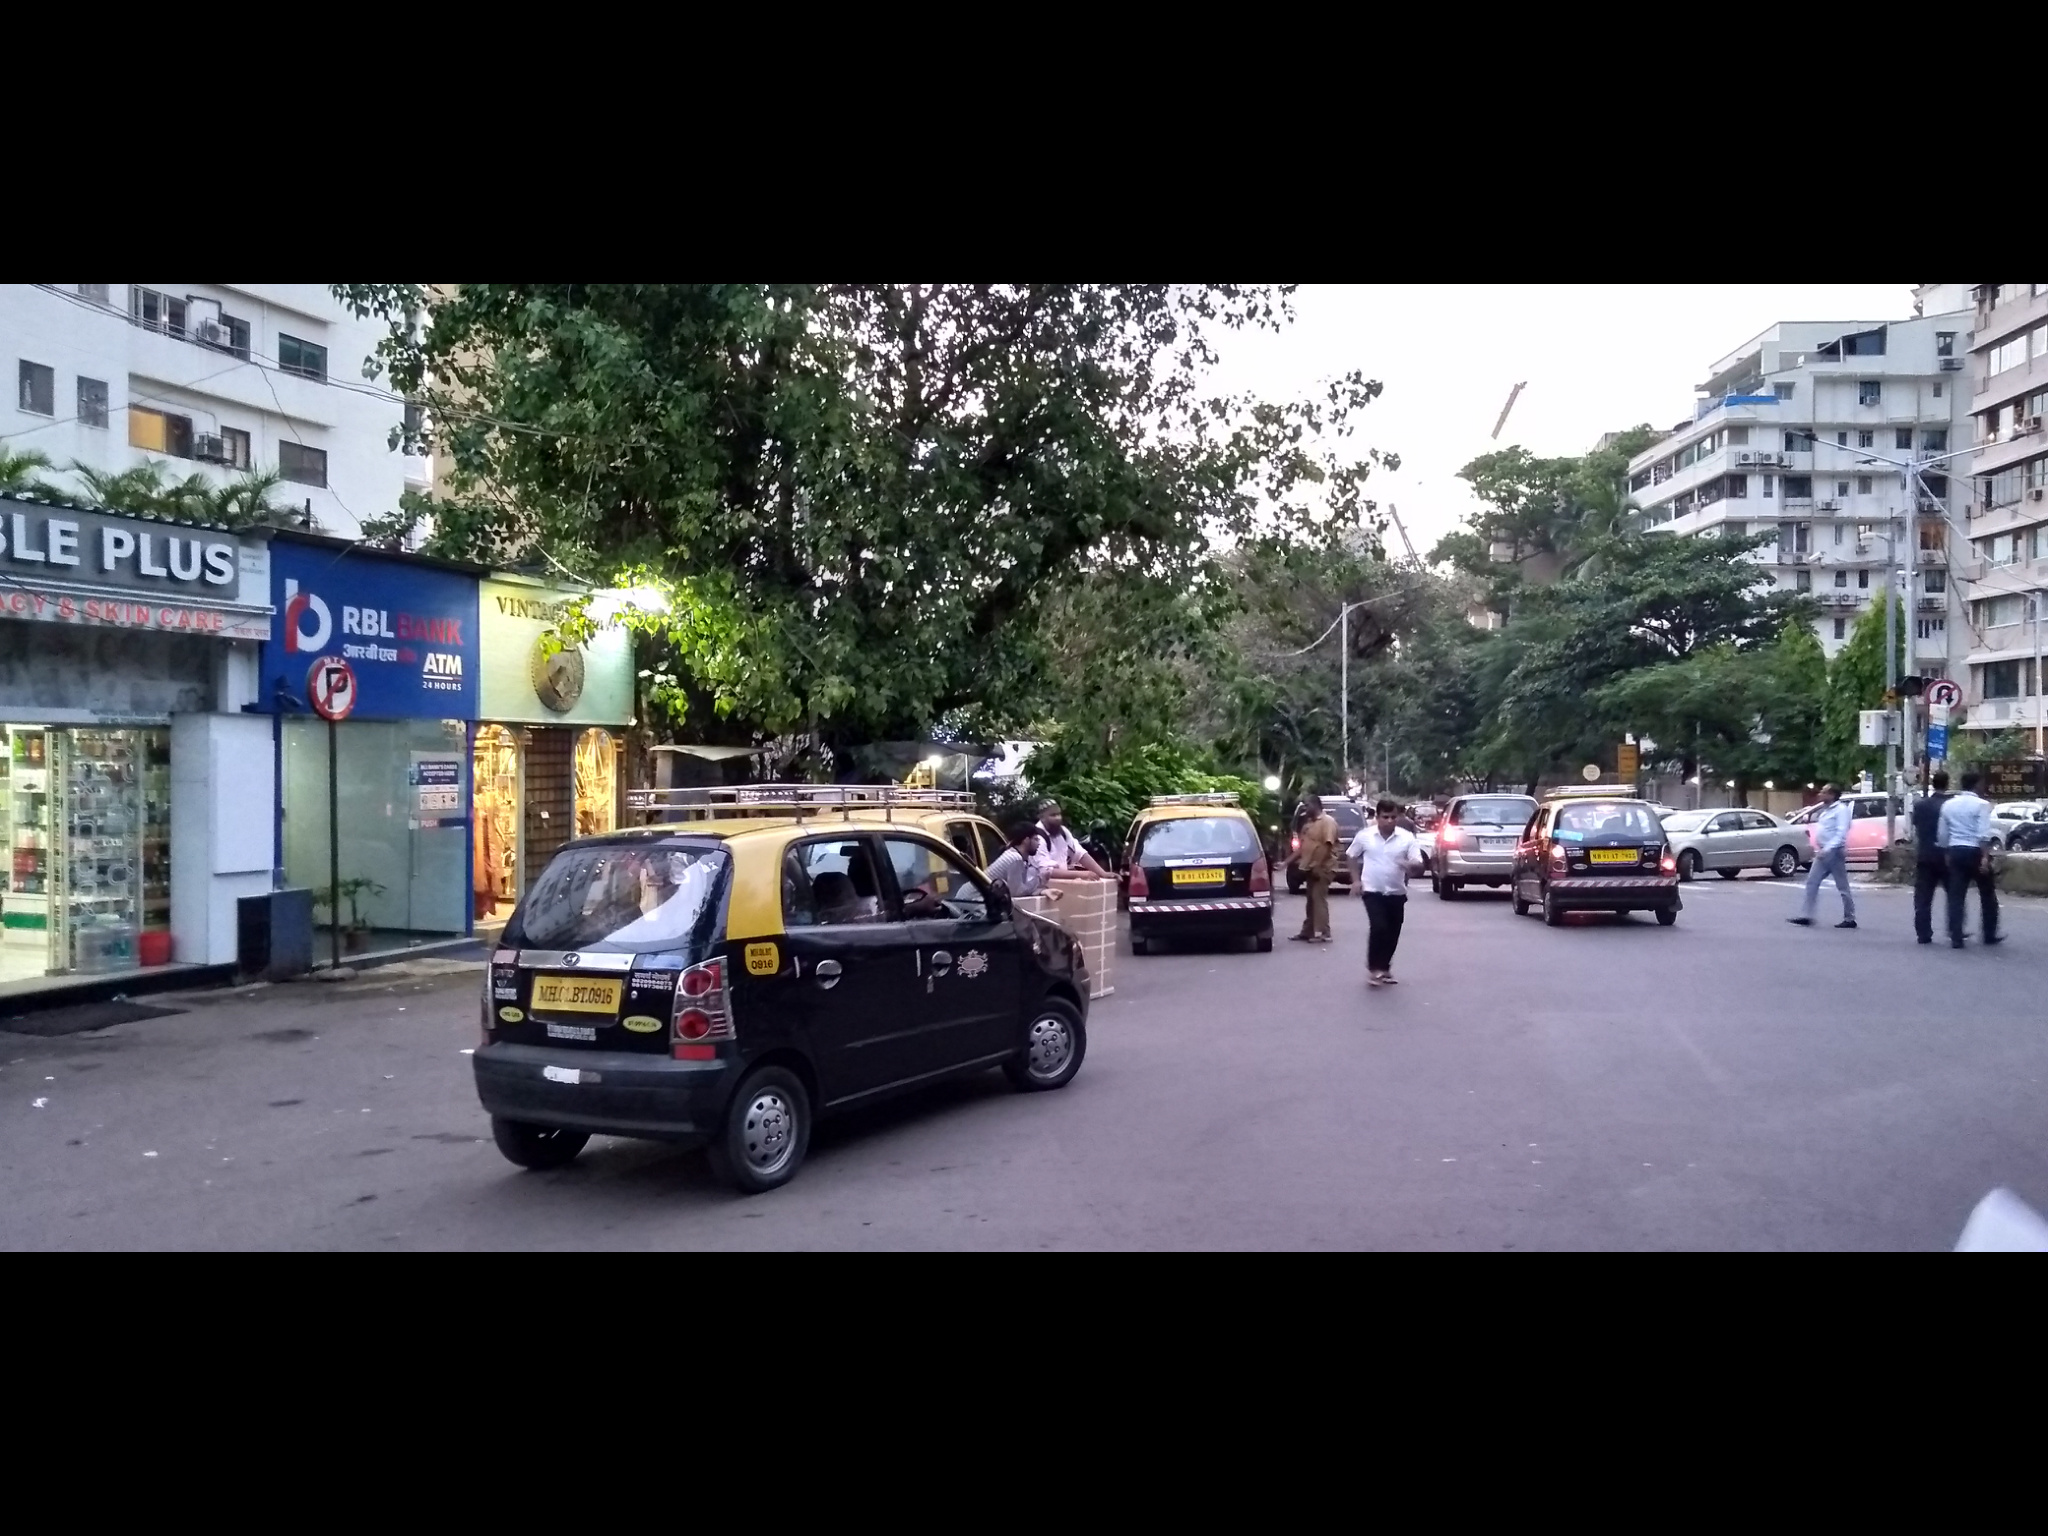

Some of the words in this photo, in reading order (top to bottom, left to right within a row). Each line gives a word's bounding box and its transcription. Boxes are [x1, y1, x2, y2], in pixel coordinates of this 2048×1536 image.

[0, 513, 80, 566] LE
[103, 526, 234, 585] PLUS
[59, 597, 75, 617] &
[86, 599, 149, 623] SKIN
[159, 607, 224, 631] CARE
[343, 605, 395, 638] RBL
[398, 613, 463, 646] BANK
[422, 653, 462, 676] ATM
[422, 681, 433, 689] 24
[434, 682, 462, 691] HOURS
[421, 819, 437, 828] PUSH
[751, 960, 774, 970] 0916
